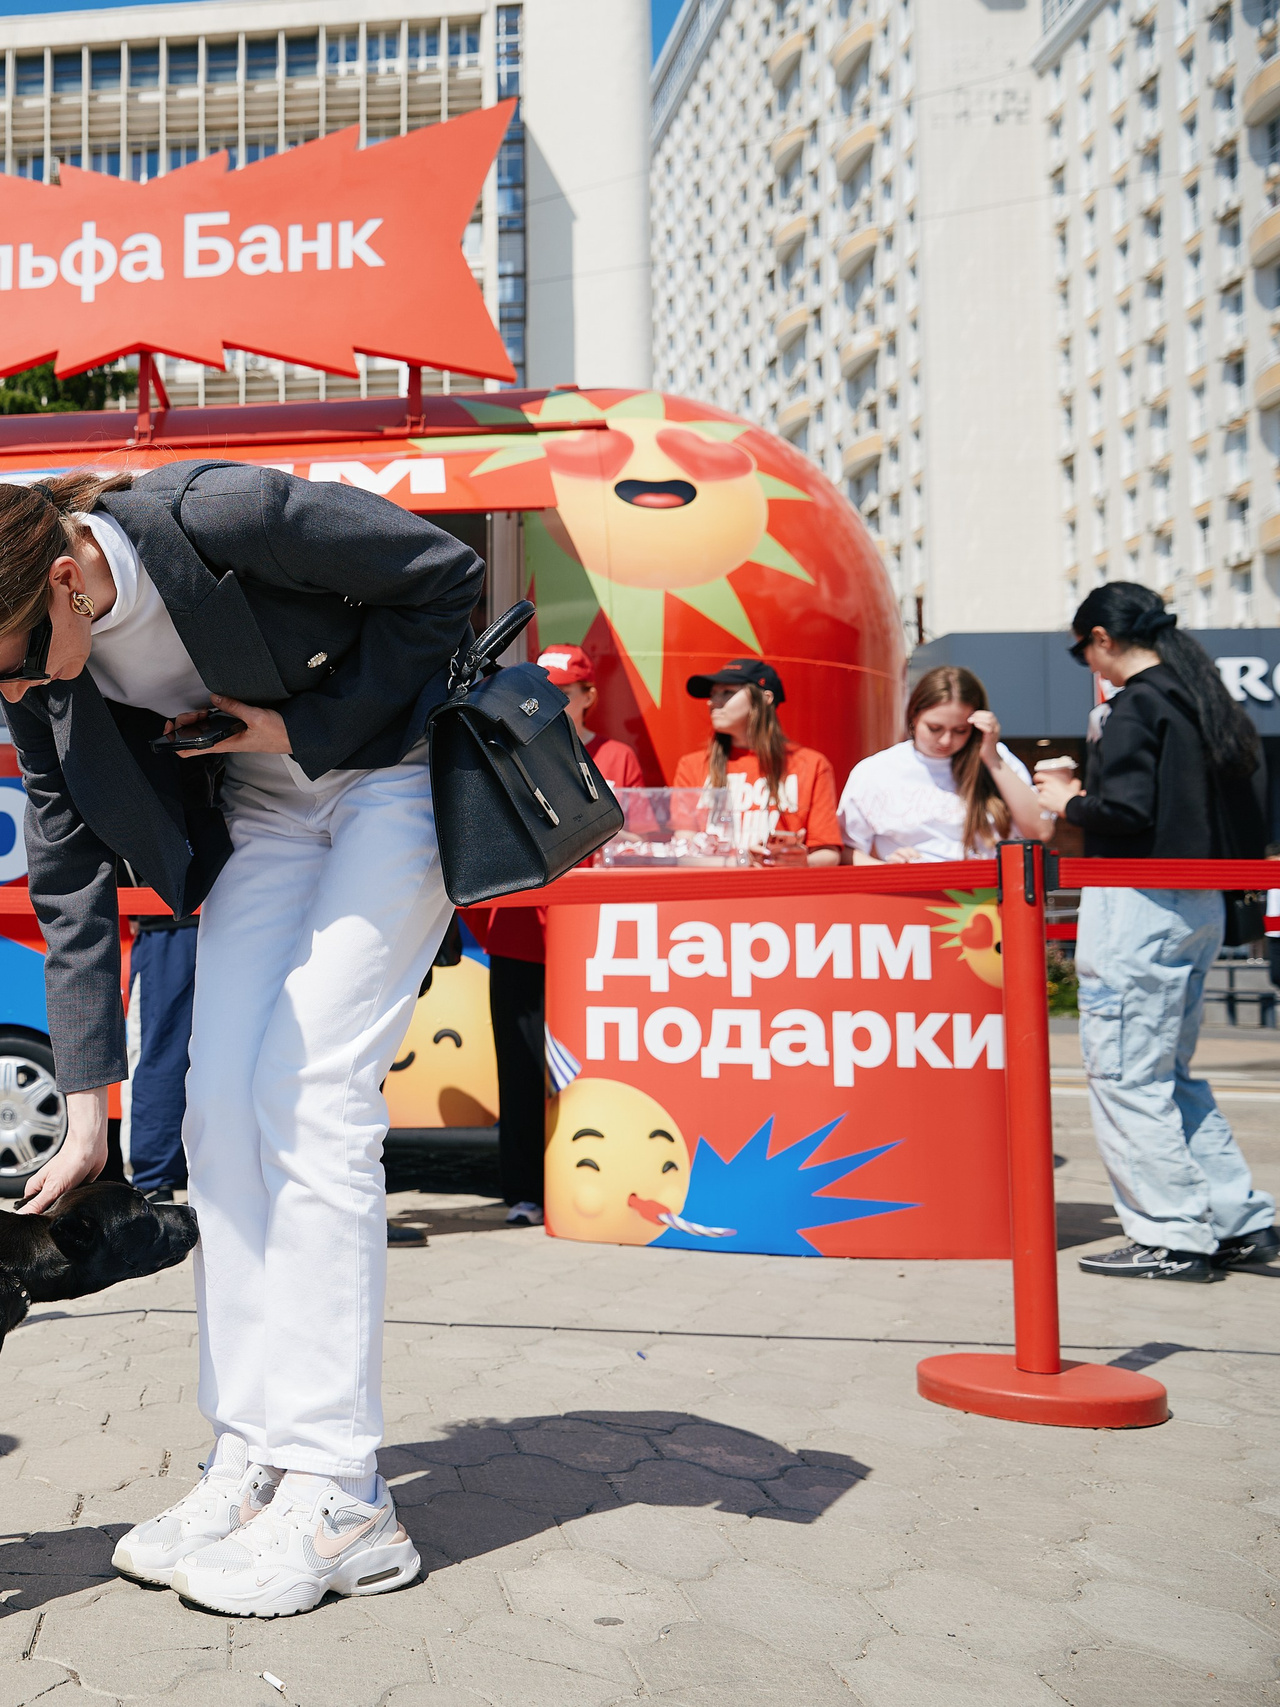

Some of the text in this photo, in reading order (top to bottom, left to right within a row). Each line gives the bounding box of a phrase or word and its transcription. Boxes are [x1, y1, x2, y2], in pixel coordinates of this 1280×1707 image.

[184, 211, 386, 277] Банк
[1215, 656, 1280, 702] R
[586, 903, 931, 997] Дарим
[586, 1007, 1005, 1087] подарки
